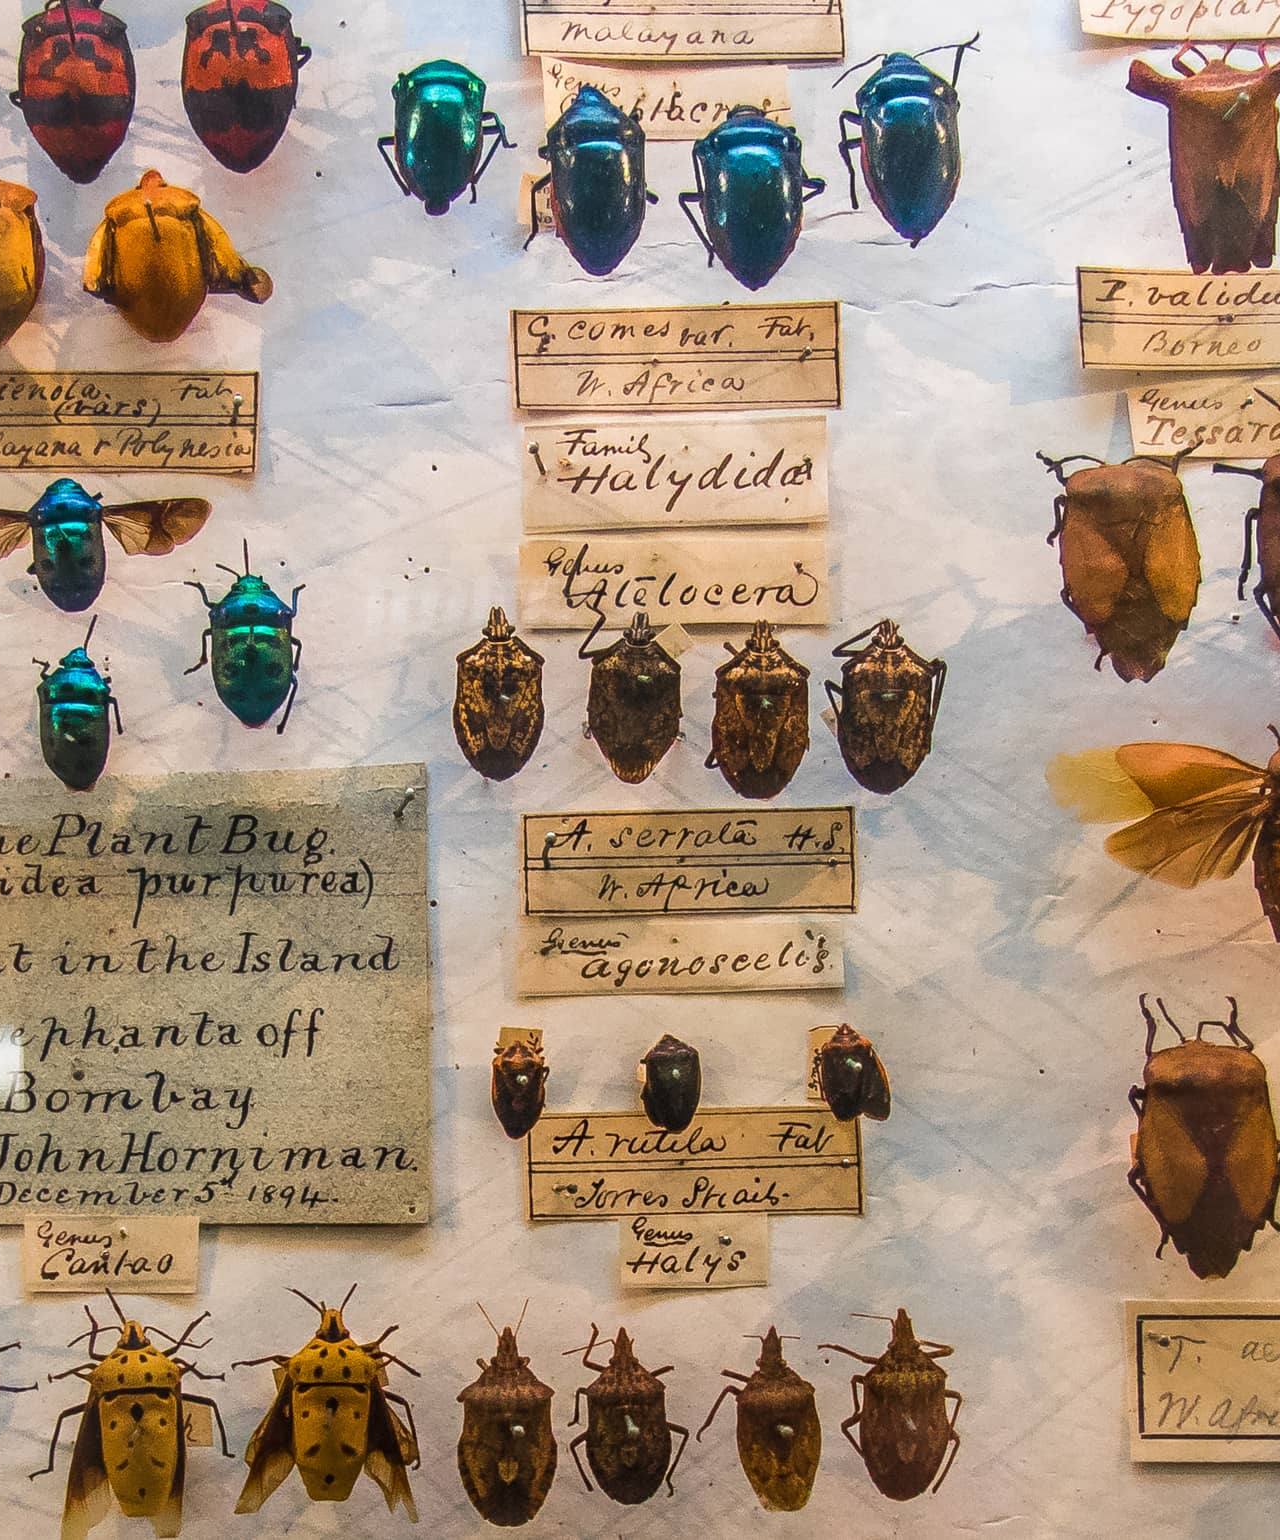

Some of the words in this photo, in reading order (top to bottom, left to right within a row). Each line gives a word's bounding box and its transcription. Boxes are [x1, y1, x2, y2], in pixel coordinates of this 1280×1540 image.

[560, 21, 756, 53] Malayana
[568, 323, 669, 340] comes
[1143, 330, 1263, 356] Borneo
[623, 369, 745, 402] Africa
[1140, 389, 1223, 413] Genus
[41, 814, 212, 857] Plant
[219, 814, 335, 866] Bug.
[610, 820, 757, 851] serrata
[132, 858, 374, 927] purpurea)
[637, 869, 769, 911] Africa
[52, 942, 120, 975] in
[132, 936, 225, 974] the
[231, 932, 401, 975] Island
[257, 1008, 325, 1058] off
[120, 1131, 419, 1180] Horniman.
[605, 1130, 727, 1154] rutila
[575, 1180, 667, 1209] Torres
[36, 1220, 115, 1248] Genus
[631, 1217, 693, 1246] Genus
[40, 1252, 173, 1279] Cantao
[627, 1249, 746, 1282] Halys
